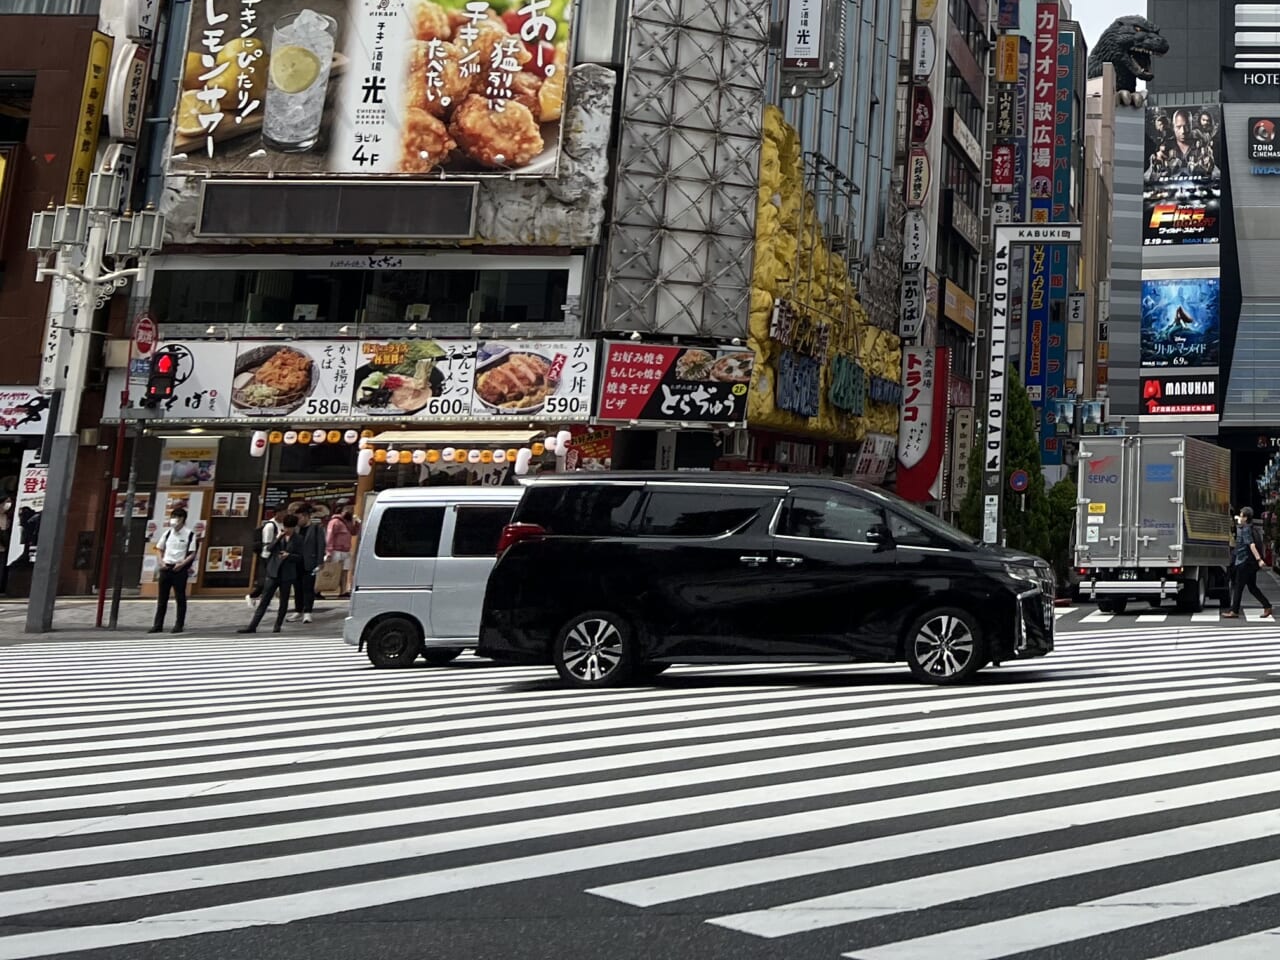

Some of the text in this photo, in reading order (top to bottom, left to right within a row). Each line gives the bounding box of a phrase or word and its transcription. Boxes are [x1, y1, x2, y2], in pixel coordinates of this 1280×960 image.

[459, 0, 491, 80] チキンが
[796, 29, 811, 45] 光
[427, 37, 452, 108] たべたい。
[487, 39, 522, 114] 猛烈に
[361, 75, 386, 104] 光
[1032, 9, 1056, 169] カラオケ歌広場
[352, 144, 380, 167] 4F
[611, 351, 665, 364] お好み焼き
[988, 262, 1008, 451] GODZILLA ROAD
[1154, 343, 1207, 355] リトル・マーメイド
[570, 343, 590, 393] かつ丼
[610, 366, 664, 379] もんじゃ焼き
[606, 382, 651, 395] 焼きそば
[904, 352, 921, 423] トラノコ
[1165, 381, 1215, 396] MARUHAN
[605, 398, 627, 410] ピザ
[1088, 474, 1118, 484] SEINO
